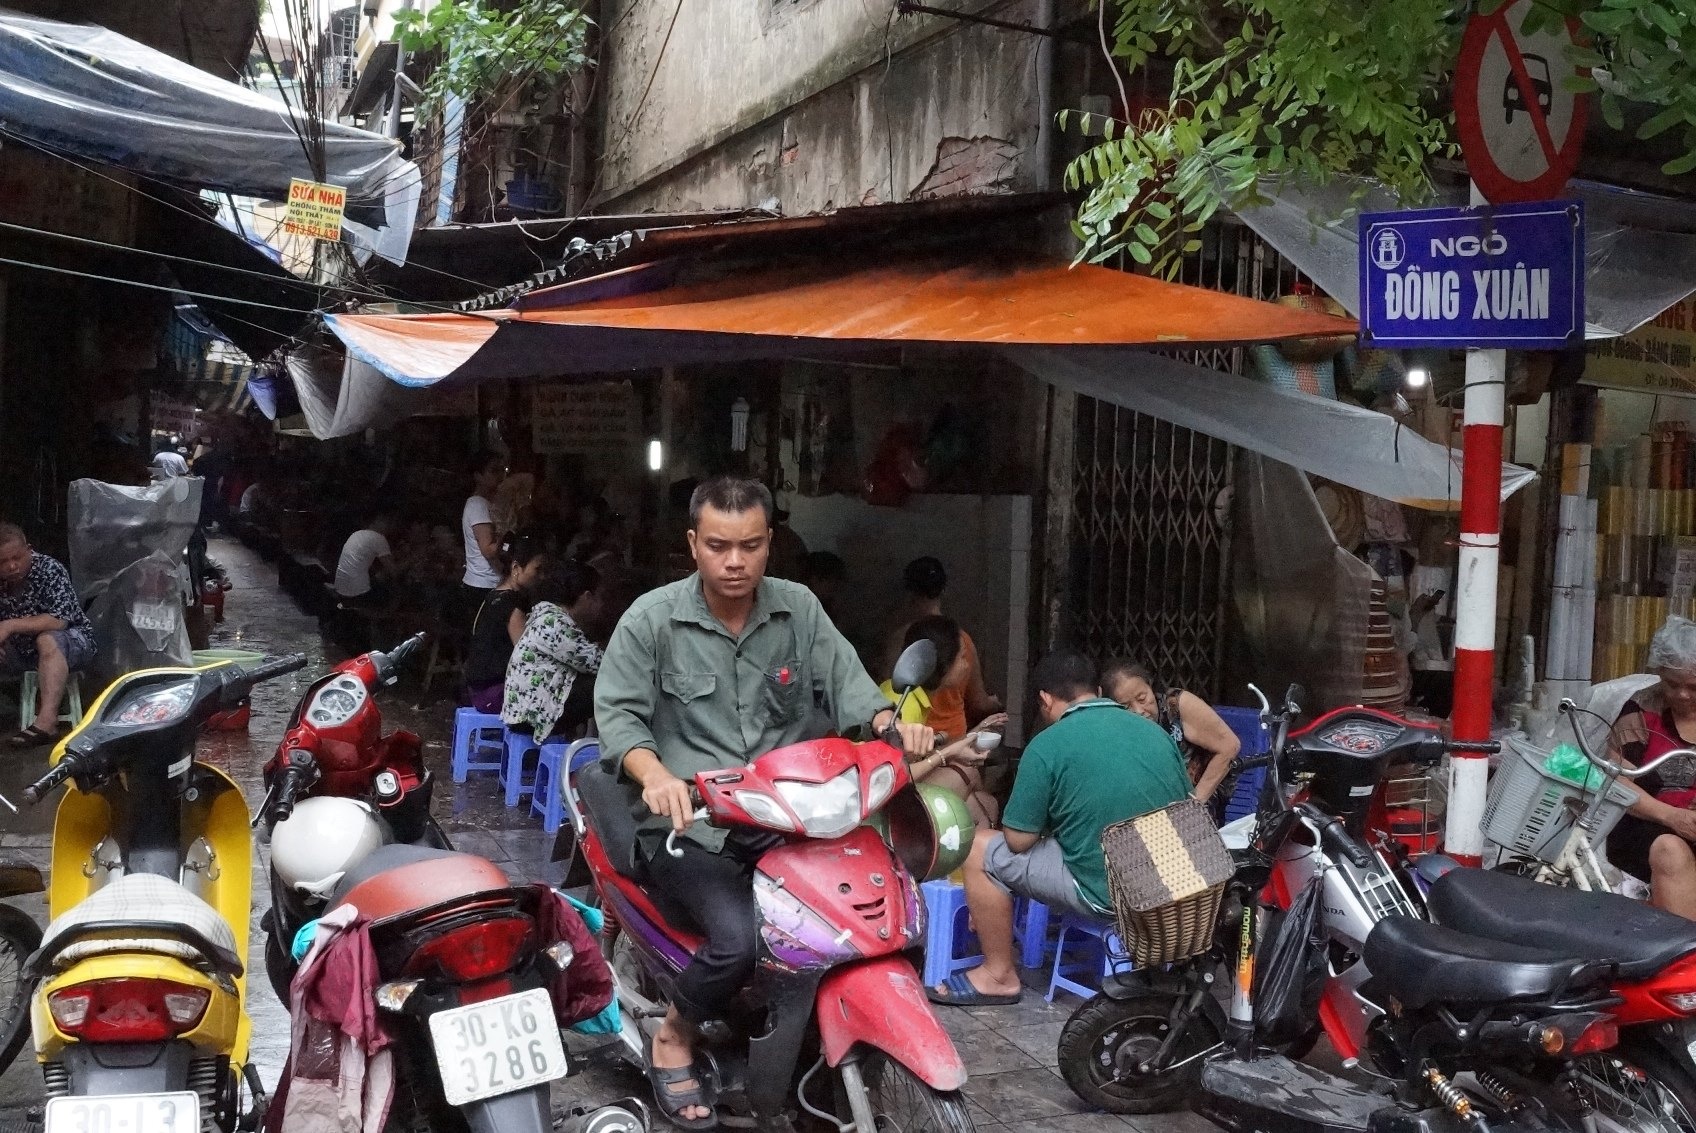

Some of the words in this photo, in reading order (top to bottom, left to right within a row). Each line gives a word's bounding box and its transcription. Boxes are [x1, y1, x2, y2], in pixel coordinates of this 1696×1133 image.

[291, 183, 315, 202] SỬA
[319, 190, 343, 207] NHÀ
[1384, 264, 1460, 321] ĐỒNG
[1472, 261, 1550, 321] XUÂN
[1239, 906, 1251, 974] momentum
[451, 999, 538, 1052] 30-K6
[460, 1039, 548, 1093] 3286
